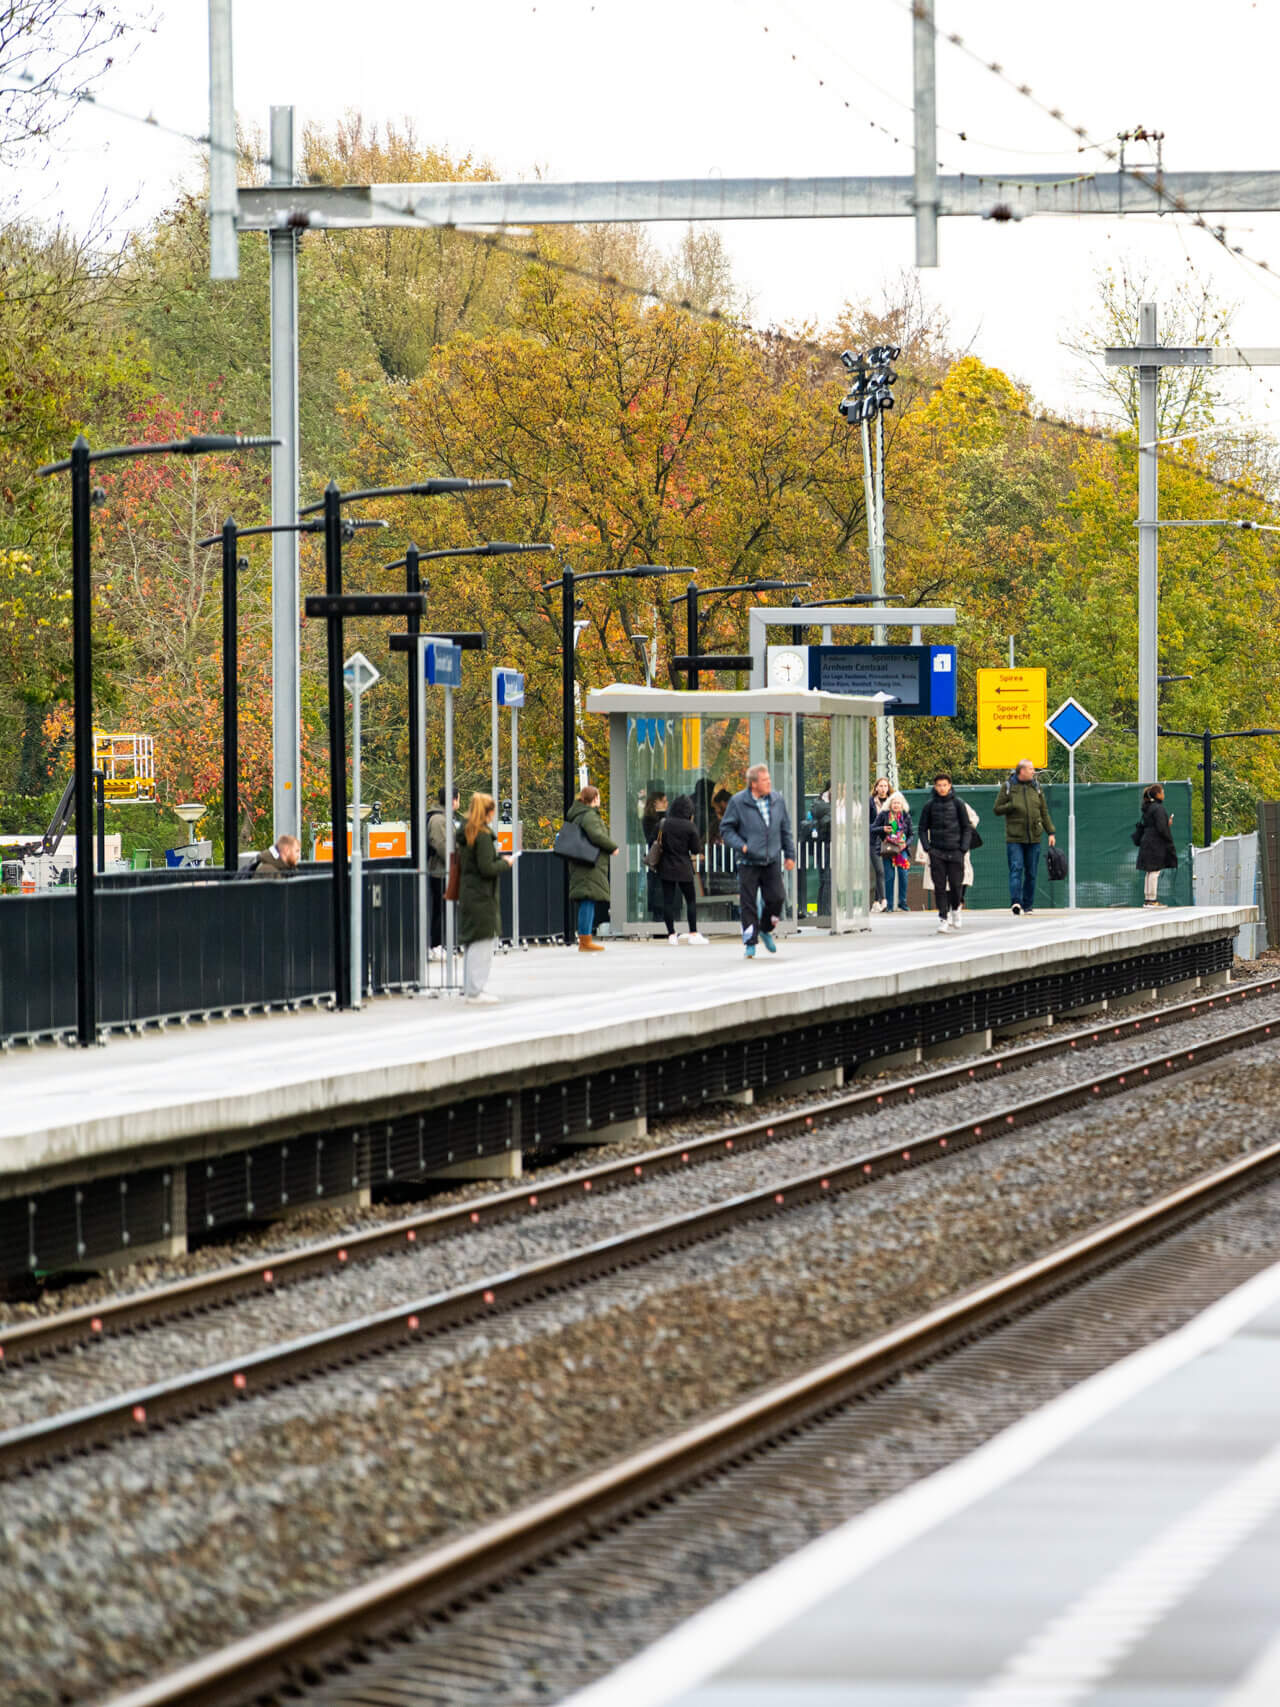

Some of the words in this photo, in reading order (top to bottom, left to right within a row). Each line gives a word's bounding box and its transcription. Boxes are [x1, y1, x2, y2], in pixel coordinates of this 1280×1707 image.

[999, 674, 1023, 682] Spirea
[996, 704, 1018, 712] Spoor
[993, 713, 1031, 721] Dordrecht
